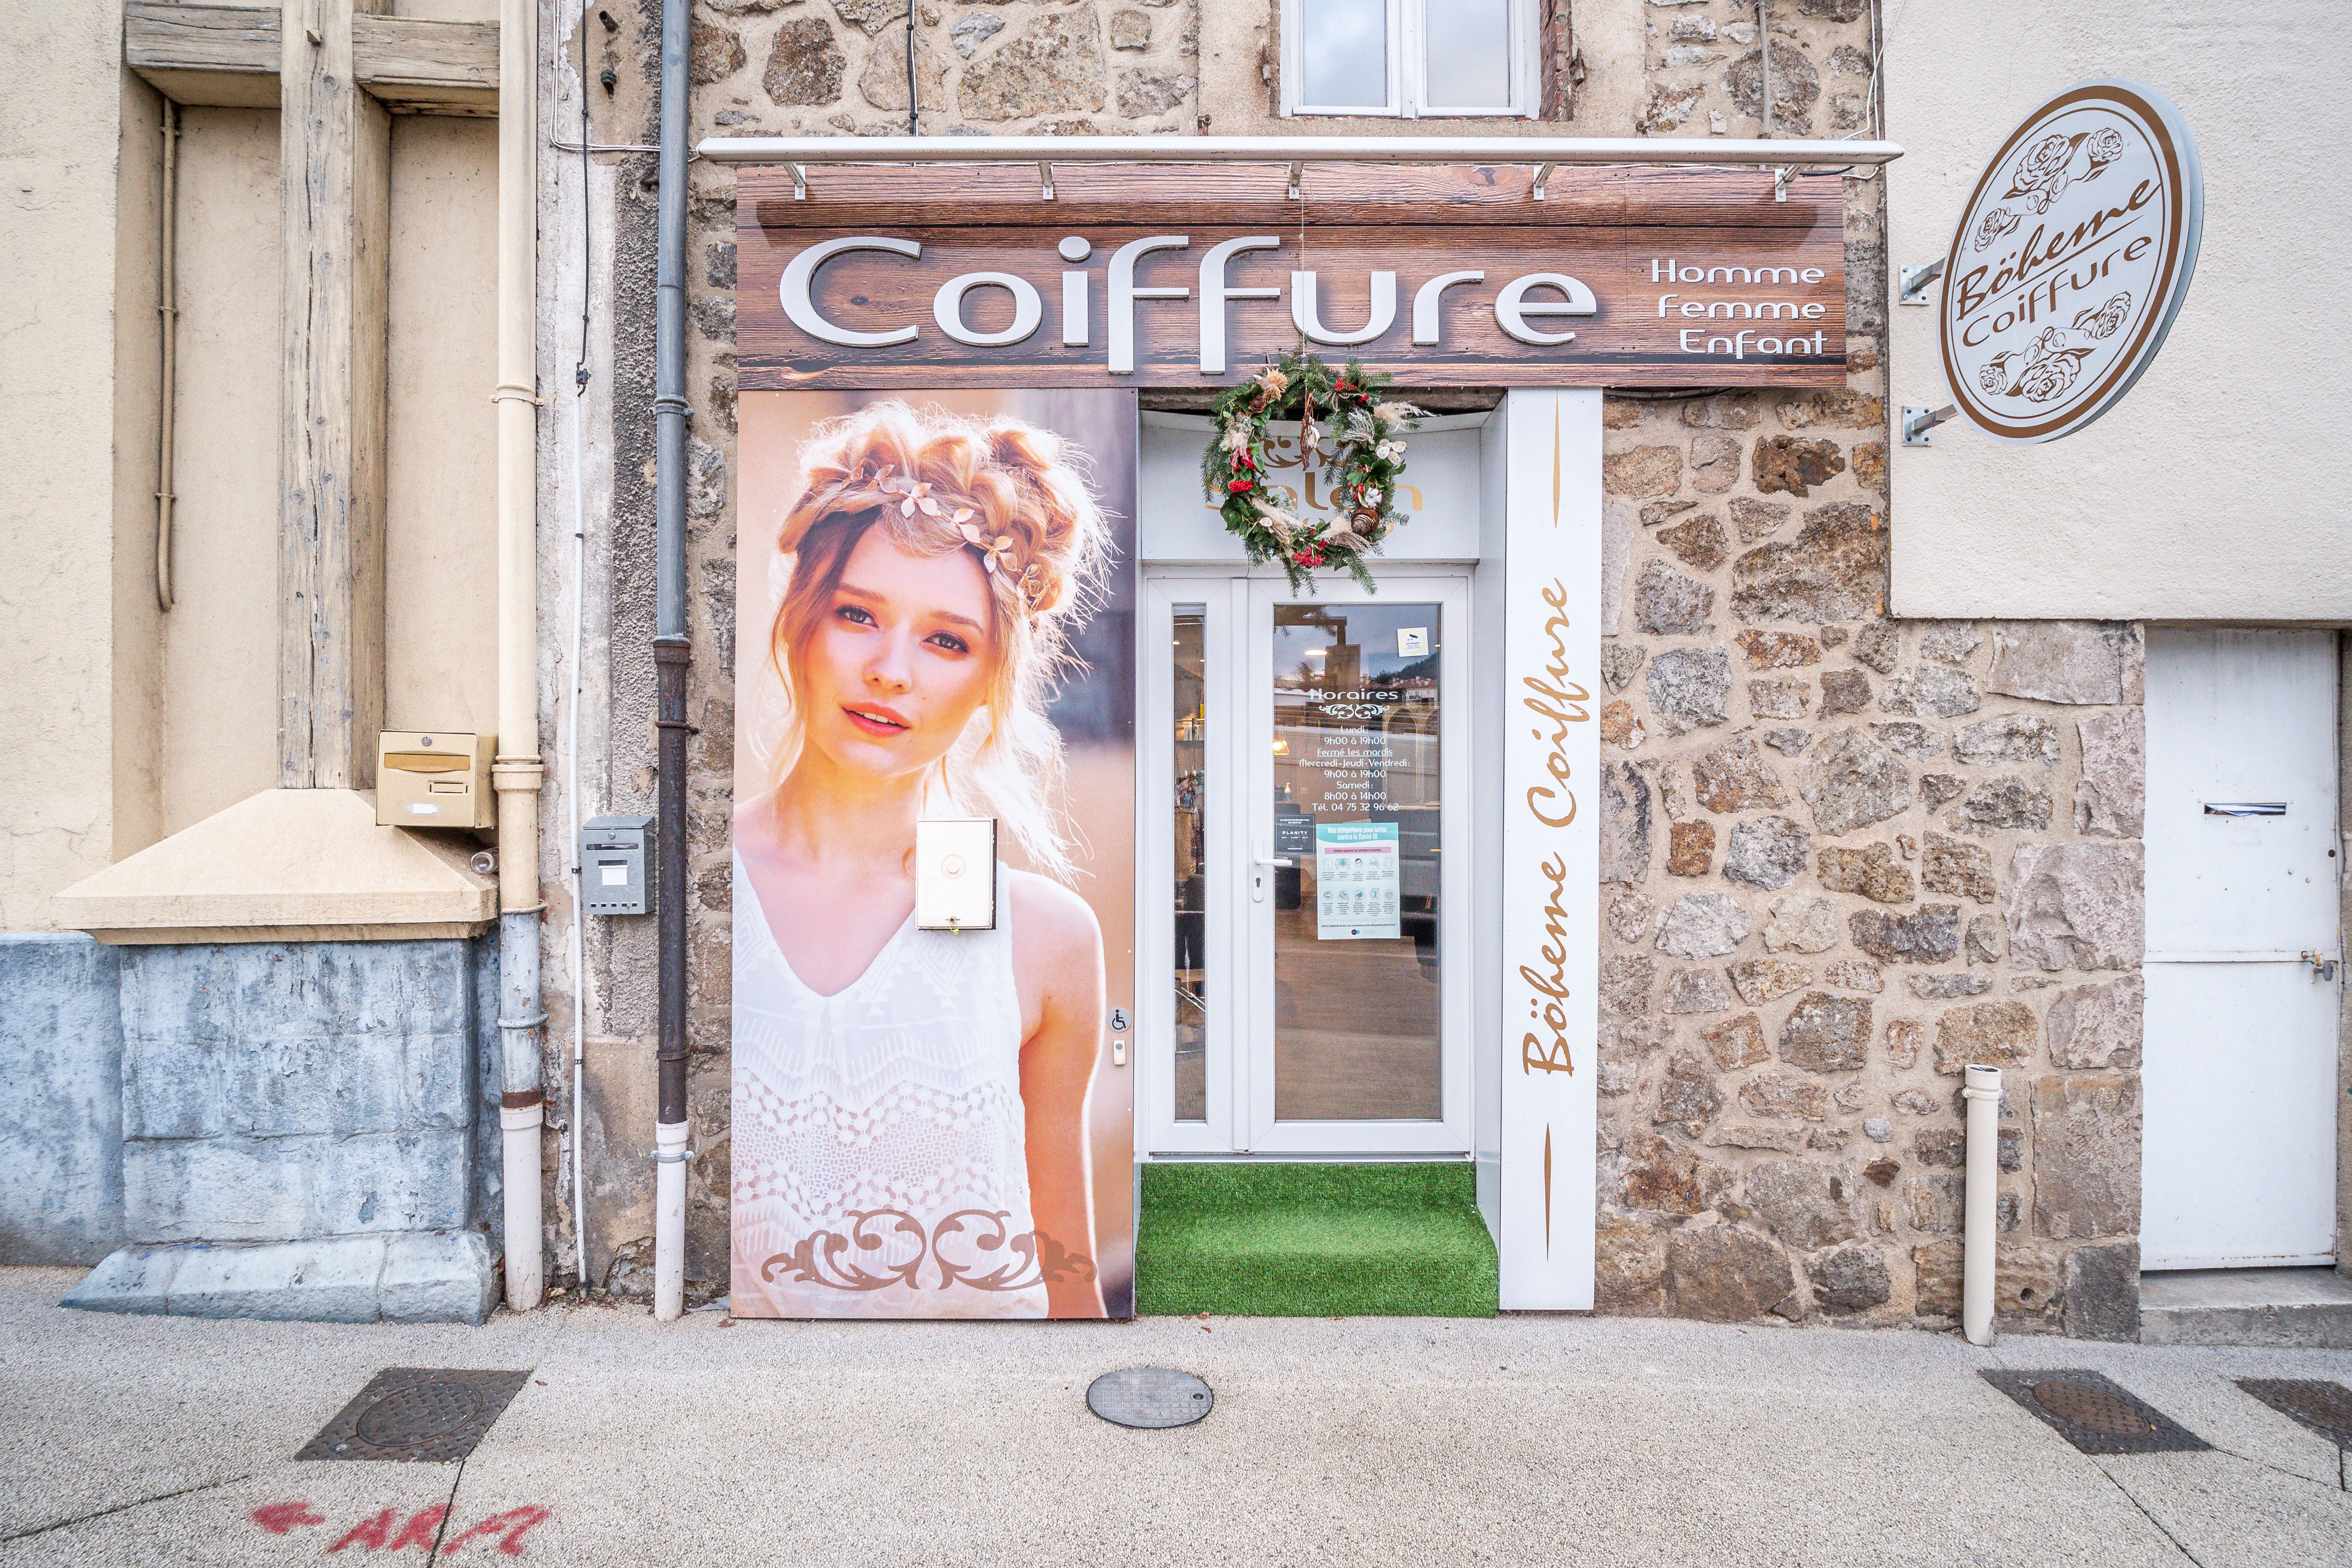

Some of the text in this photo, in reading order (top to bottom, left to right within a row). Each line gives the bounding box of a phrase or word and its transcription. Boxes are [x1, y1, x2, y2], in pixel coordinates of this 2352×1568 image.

[1956, 178, 2163, 322] Böheme
[1651, 259, 1825, 284] Homme
[779, 235, 1597, 374] Coiffure
[1658, 294, 1826, 318] Femme
[1962, 236, 2152, 347] Coiffure
[1680, 329, 1828, 359] Enfant
[1310, 688, 1398, 700] Horaires
[1317, 748, 1345, 756] Fermé
[1363, 748, 1393, 756] mardis
[1520, 577, 1590, 1077] Böheme Coiffure
